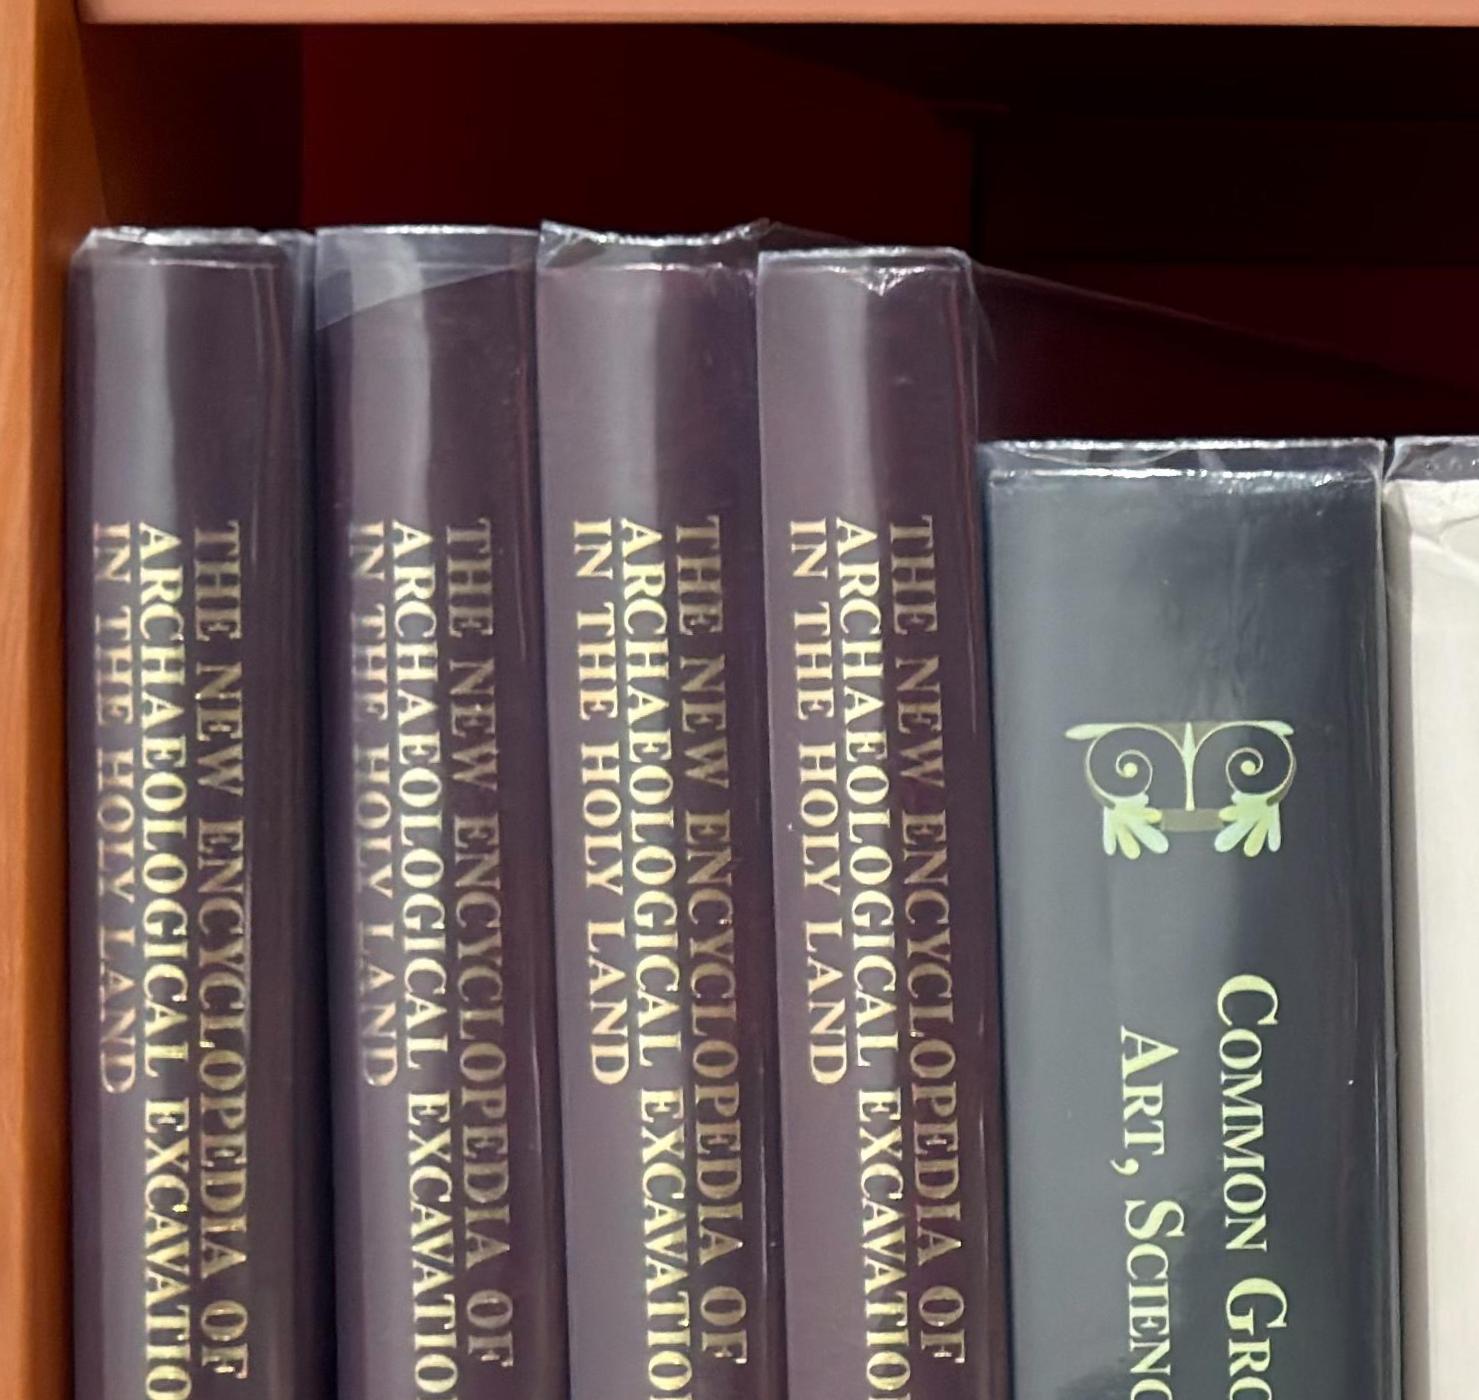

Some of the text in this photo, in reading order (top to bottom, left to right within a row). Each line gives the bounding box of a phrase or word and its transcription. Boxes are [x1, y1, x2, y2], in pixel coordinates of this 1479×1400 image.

[137, 523, 189, 1075] ARCHAEOLOGICAL
[573, 519, 630, 1086] IN THE HOLY LAND
[620, 518, 682, 1067] ARCHAEOLOGICAL
[676, 516, 747, 1365] THE NEW ENCYCLOPEDIA OF
[837, 518, 900, 1067] ARCHAEOLOGICAL
